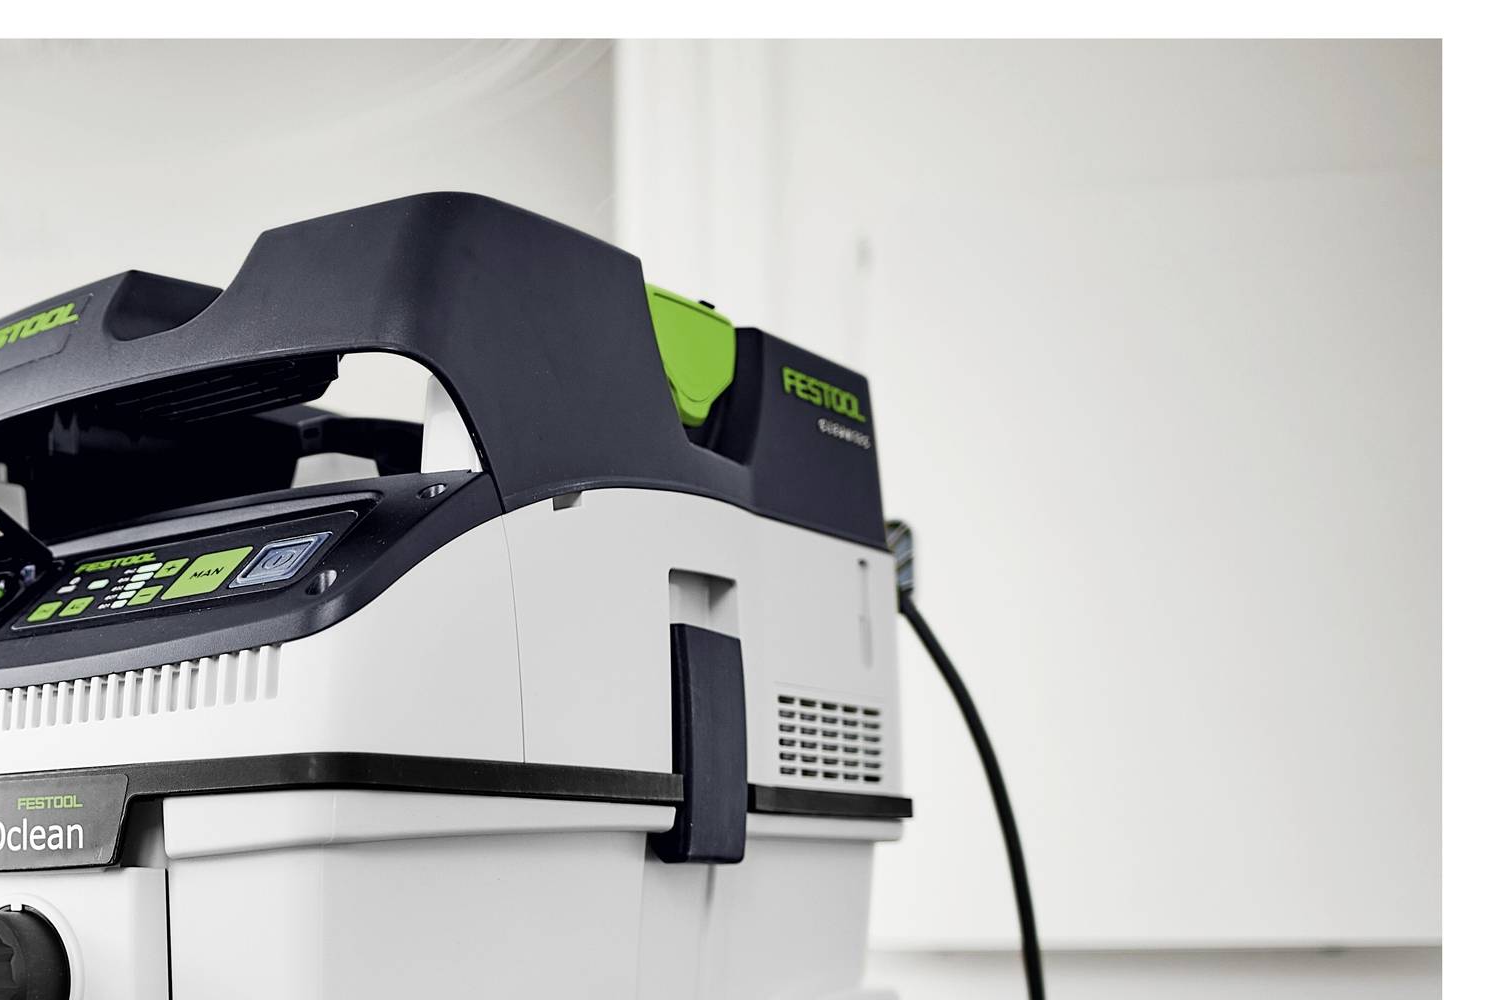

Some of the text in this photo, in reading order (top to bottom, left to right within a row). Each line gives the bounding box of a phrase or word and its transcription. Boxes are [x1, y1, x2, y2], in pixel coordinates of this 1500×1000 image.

[782, 367, 866, 422] FESTOOL
[74, 552, 157, 574] FESTOOL
[189, 566, 225, 580] MAN
[17, 795, 83, 810] FESTOOL
